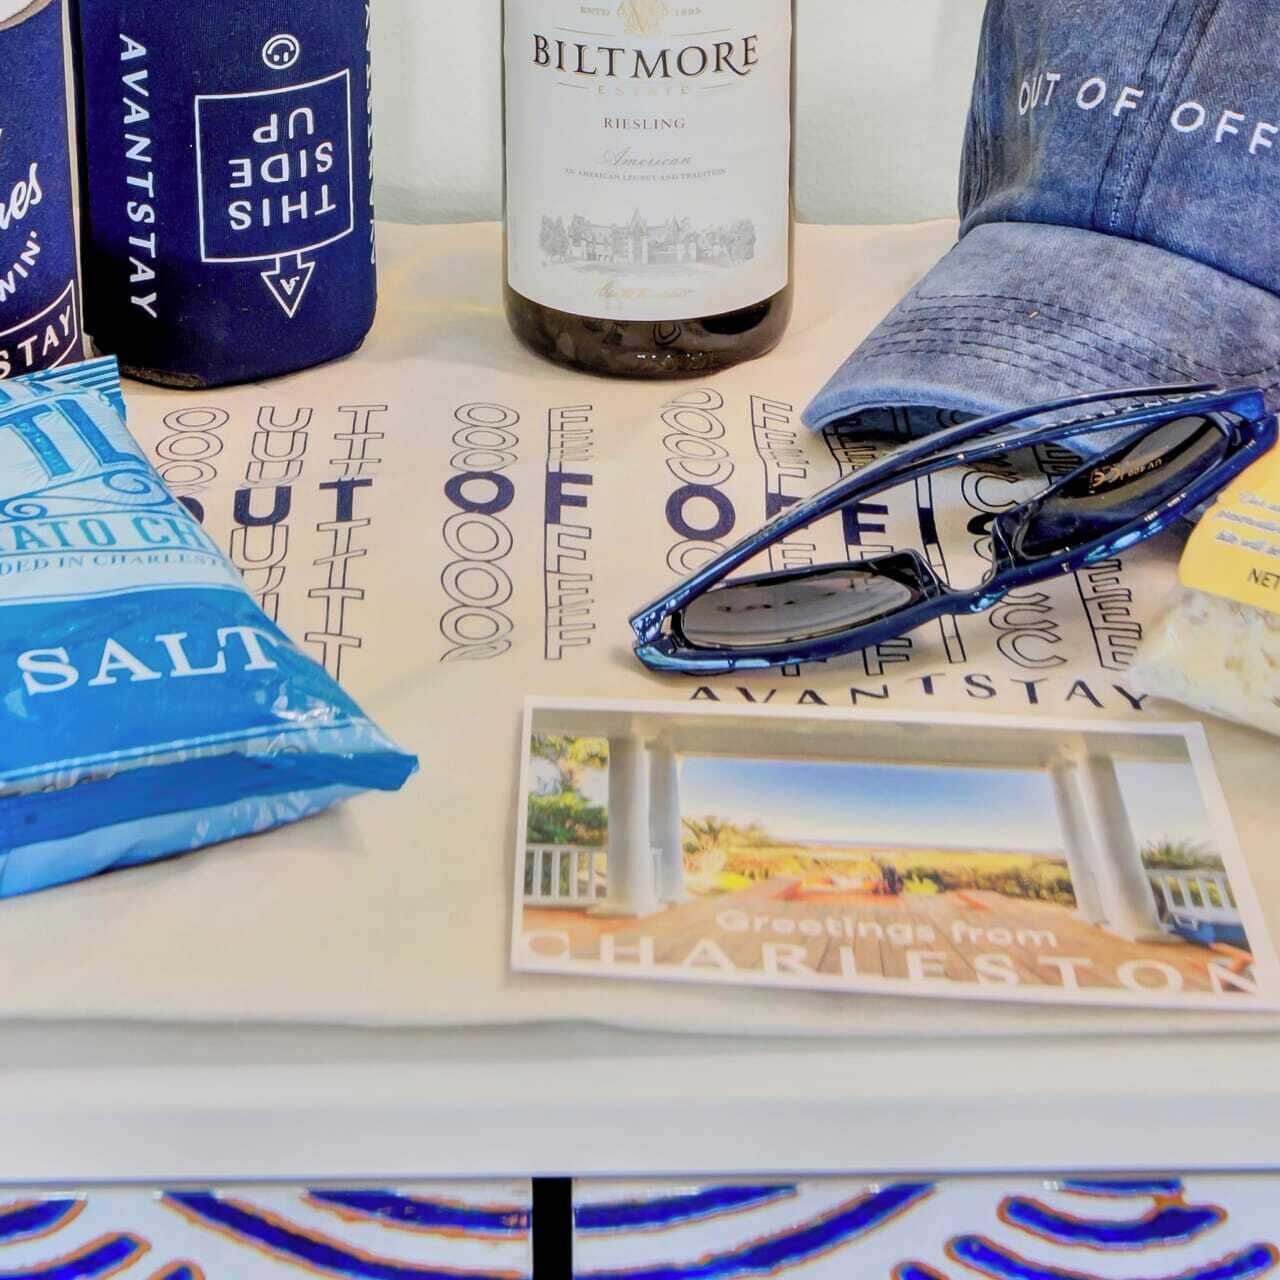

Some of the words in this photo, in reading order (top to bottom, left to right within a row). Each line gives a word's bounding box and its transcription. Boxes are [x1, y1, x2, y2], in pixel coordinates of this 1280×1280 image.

[533, 33, 759, 80] BILTMORE
[1018, 71, 1061, 116] OUT
[1075, 77, 1145, 117] OF
[252, 106, 315, 144] UP
[603, 117, 687, 131] RIESLING
[119, 32, 159, 319] AVANTSTAY
[227, 141, 334, 189] SIDE
[227, 184, 337, 231] THIS
[444, 470, 594, 525] OF
[131, 512, 210, 550] CH
[57, 555, 85, 569] IN
[92, 552, 230, 569] CHARLEST
[16, 625, 282, 697] SALT
[688, 673, 1149, 712] AVANTSTAY
[715, 908, 936, 950] Greetings
[949, 921, 1060, 949] from
[520, 930, 1262, 995] CHARLESTON
